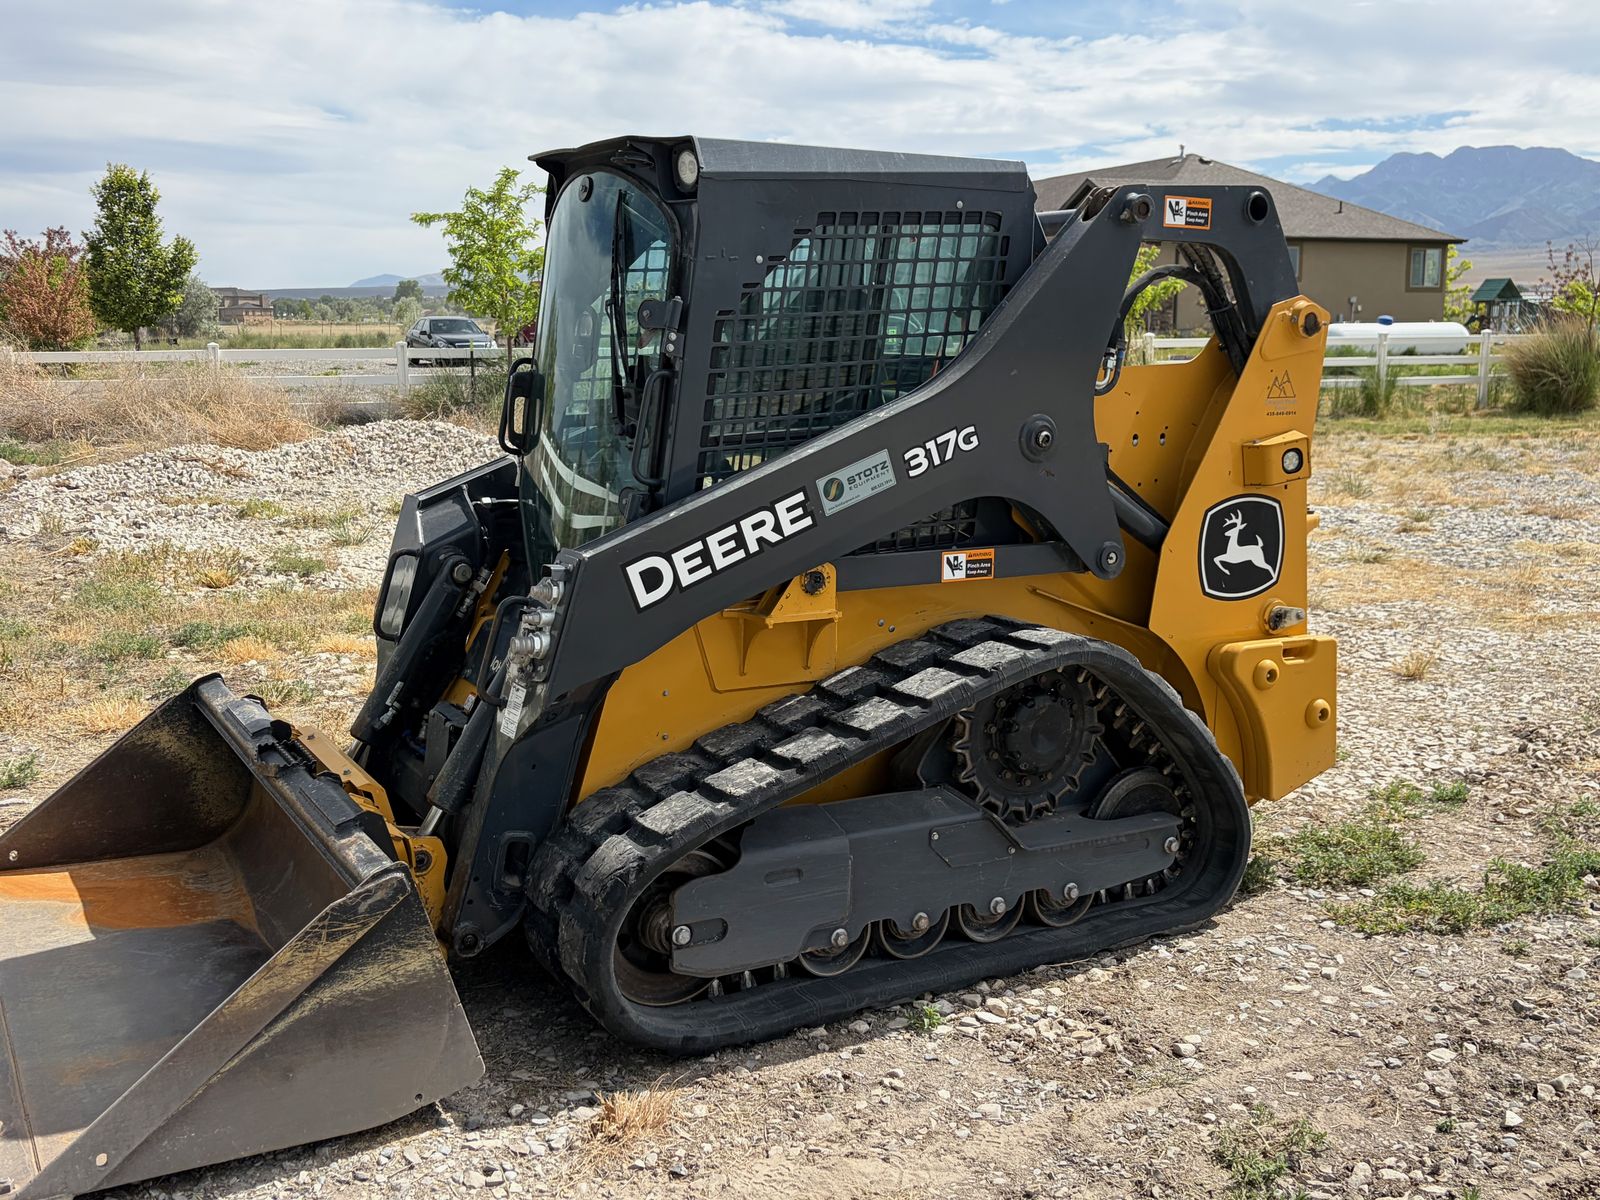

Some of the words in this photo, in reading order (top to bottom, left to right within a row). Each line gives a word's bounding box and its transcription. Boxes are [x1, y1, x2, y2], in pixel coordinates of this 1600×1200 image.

[904, 426, 979, 477] 317G
[847, 460, 889, 485] STOTZ
[849, 470, 890, 491] EQUIPMENT
[626, 491, 813, 608] DEERE
